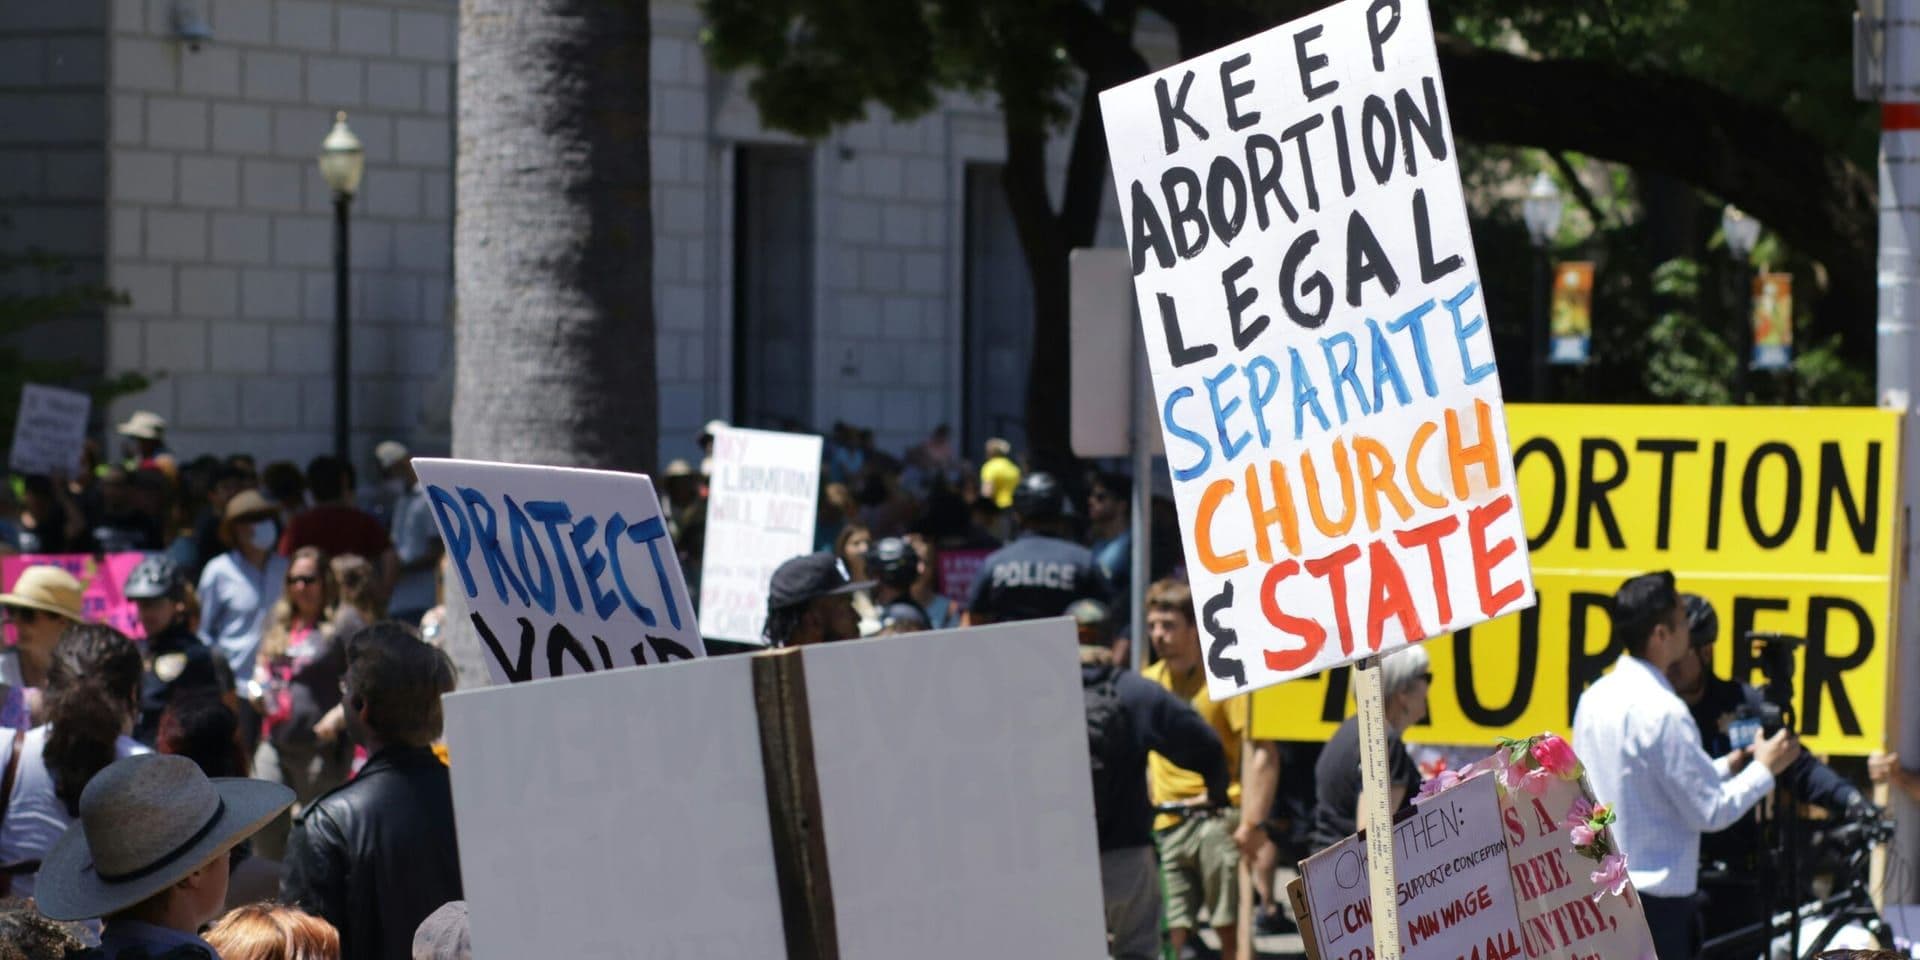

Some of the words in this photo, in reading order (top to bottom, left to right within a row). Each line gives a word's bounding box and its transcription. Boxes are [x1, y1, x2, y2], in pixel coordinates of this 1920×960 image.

[1154, 0, 1401, 155] KEEP
[1131, 76, 1447, 276] ABORTION
[1156, 188, 1465, 367] LEGAL
[1163, 281, 1497, 482] SEPARATE
[427, 485, 681, 630] PROTECT
[1194, 398, 1501, 574] CHURCH
[992, 560, 1076, 590] POLICE
[1260, 494, 1526, 671] STATE
[1531, 797, 1559, 837] A
[1407, 911, 1440, 946] MIN
[1440, 885, 1493, 929] WAGE
